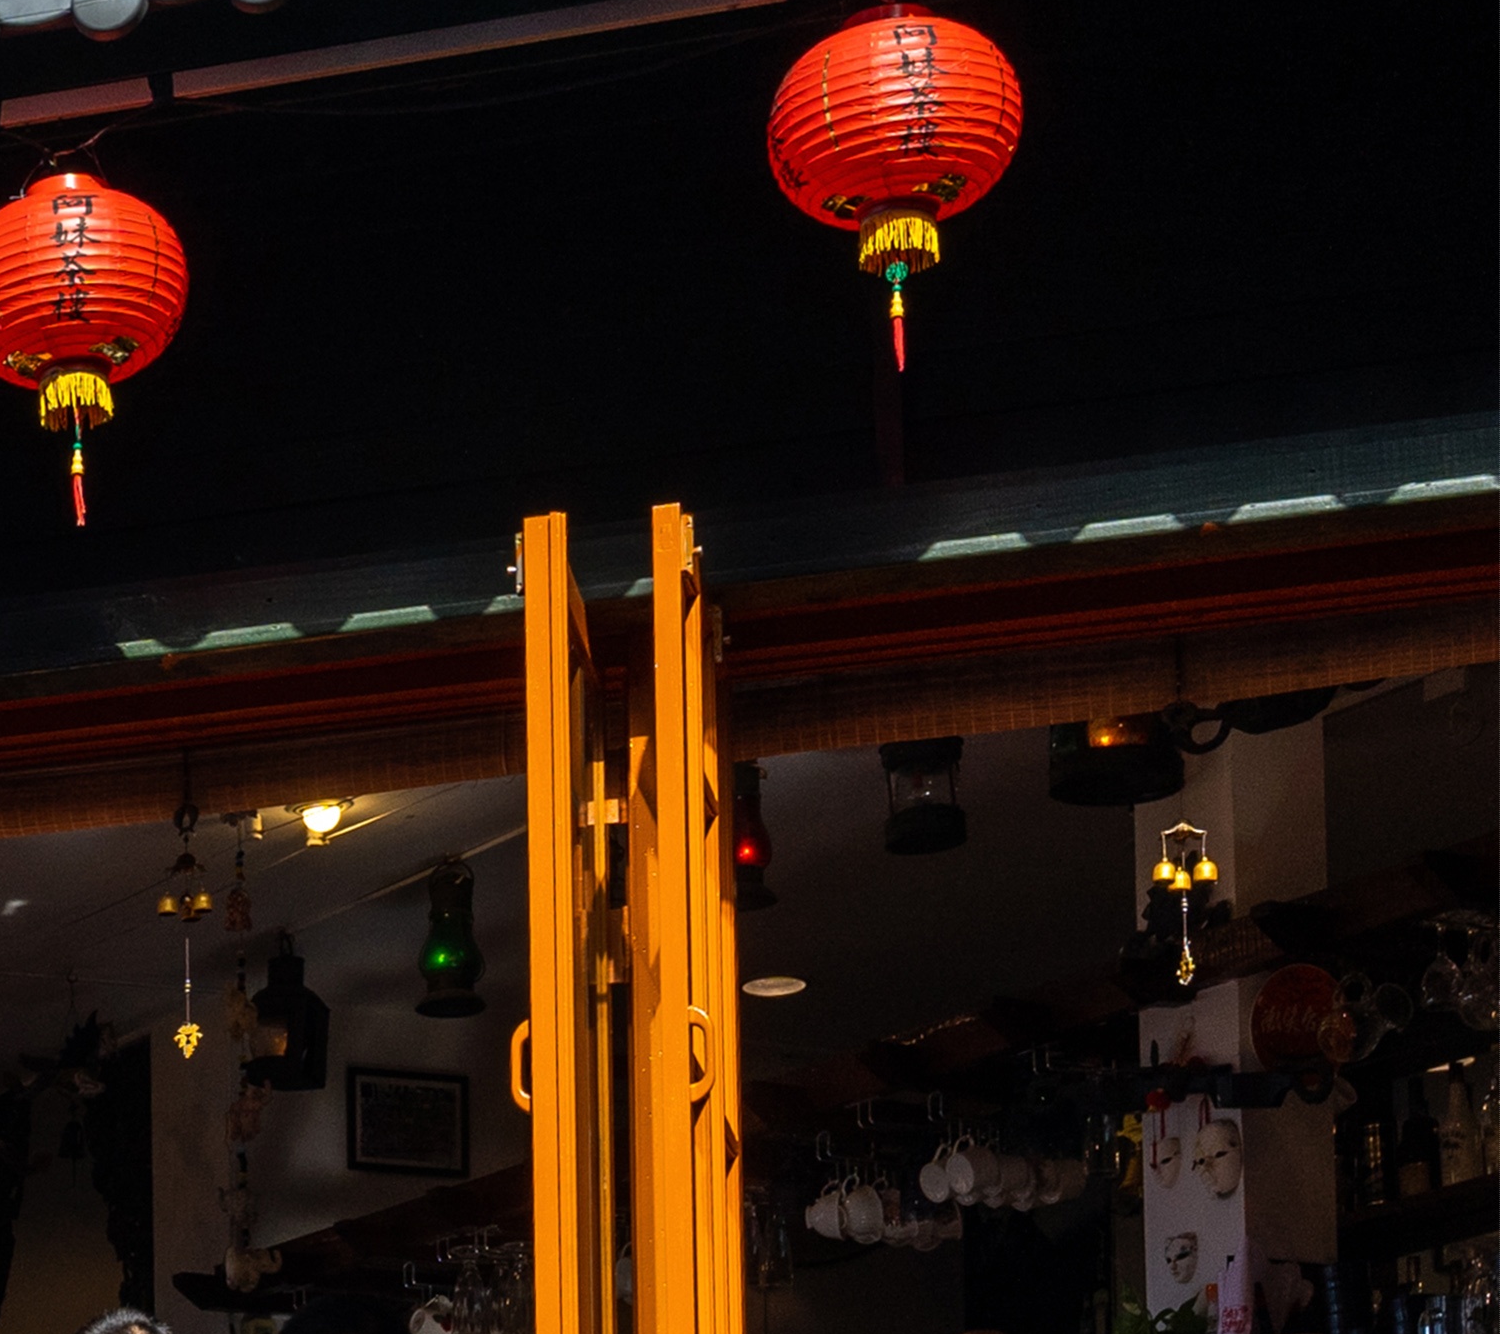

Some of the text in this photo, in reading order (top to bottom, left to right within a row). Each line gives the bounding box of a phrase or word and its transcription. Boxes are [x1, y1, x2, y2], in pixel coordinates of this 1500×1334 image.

[893, 24, 950, 157] 阿妹茶樓
[50, 194, 101, 323] 阿妹茶樓
